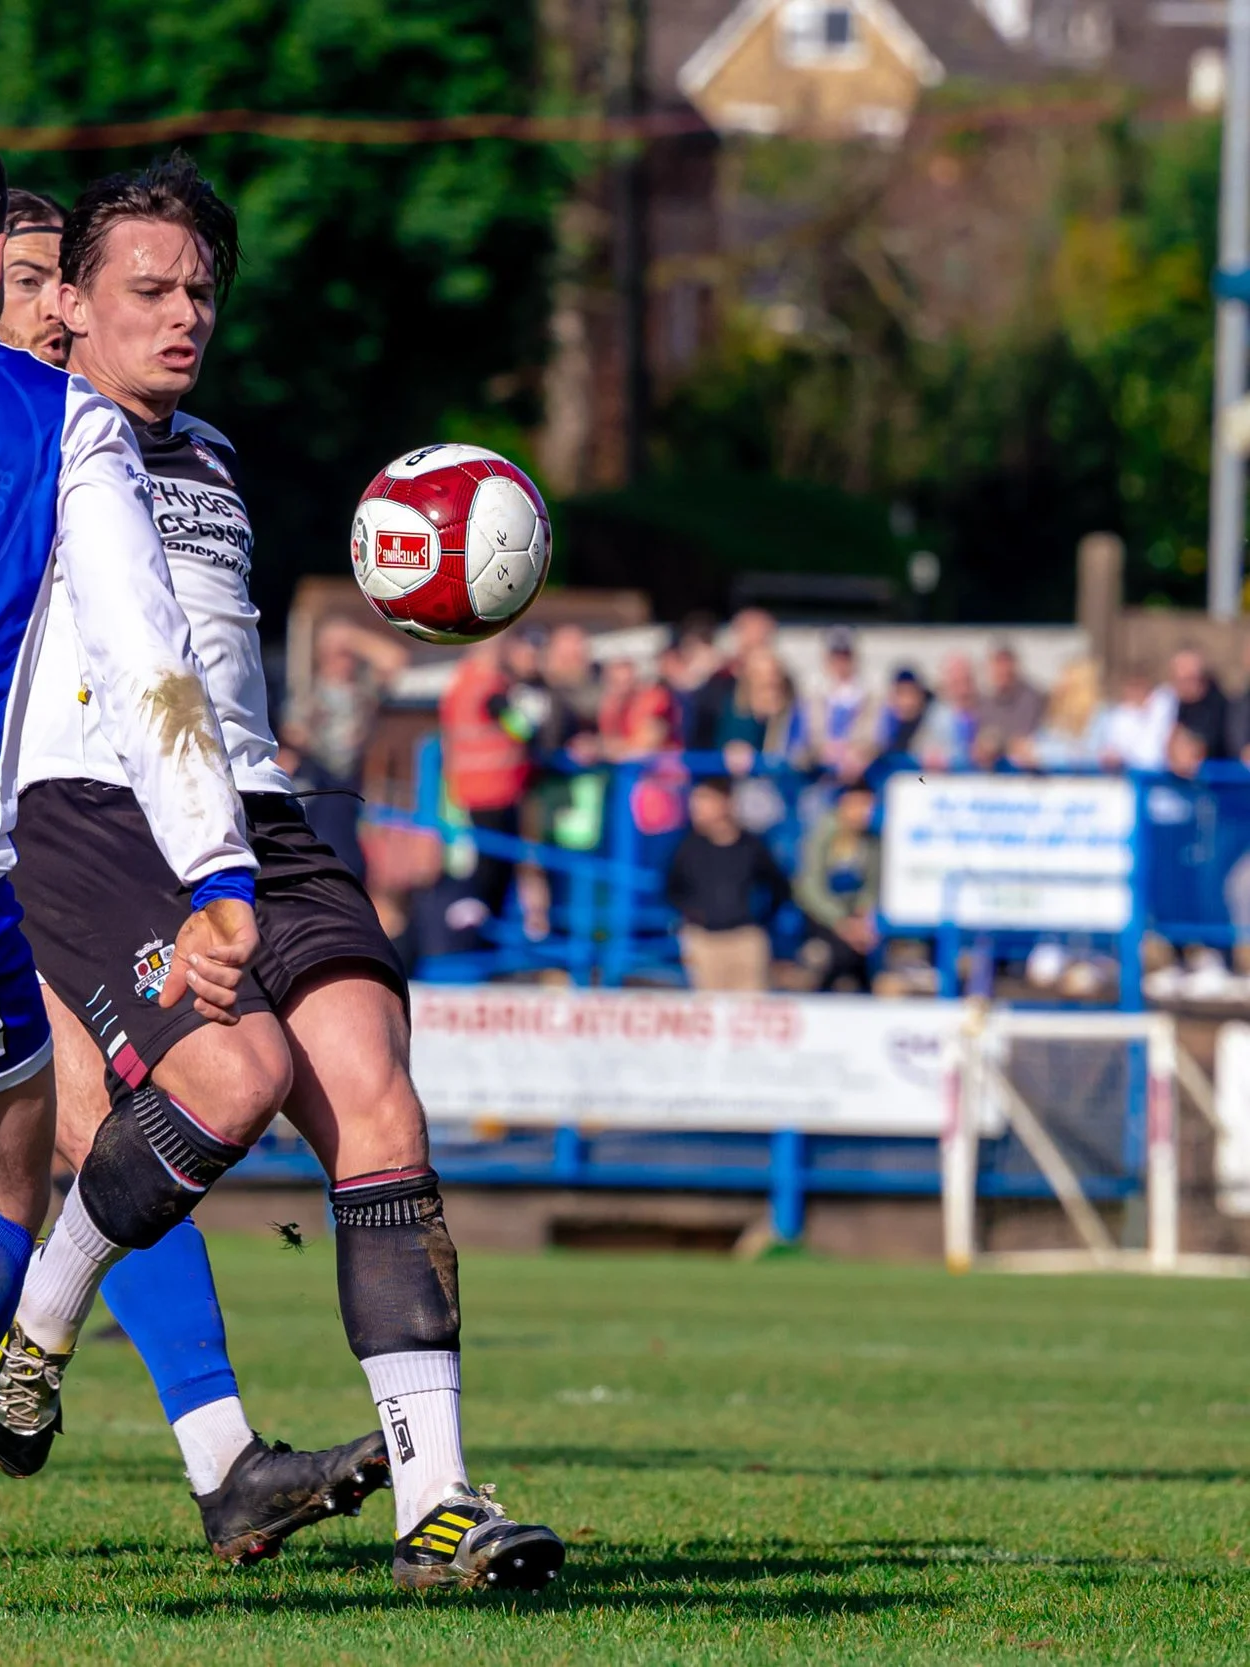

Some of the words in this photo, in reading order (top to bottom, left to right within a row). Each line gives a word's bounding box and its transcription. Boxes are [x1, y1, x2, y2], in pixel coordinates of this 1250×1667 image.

[158, 481, 234, 518] Hyde
[382, 548, 420, 564] PITCHING
[136, 967, 166, 991] MOSSLEY
